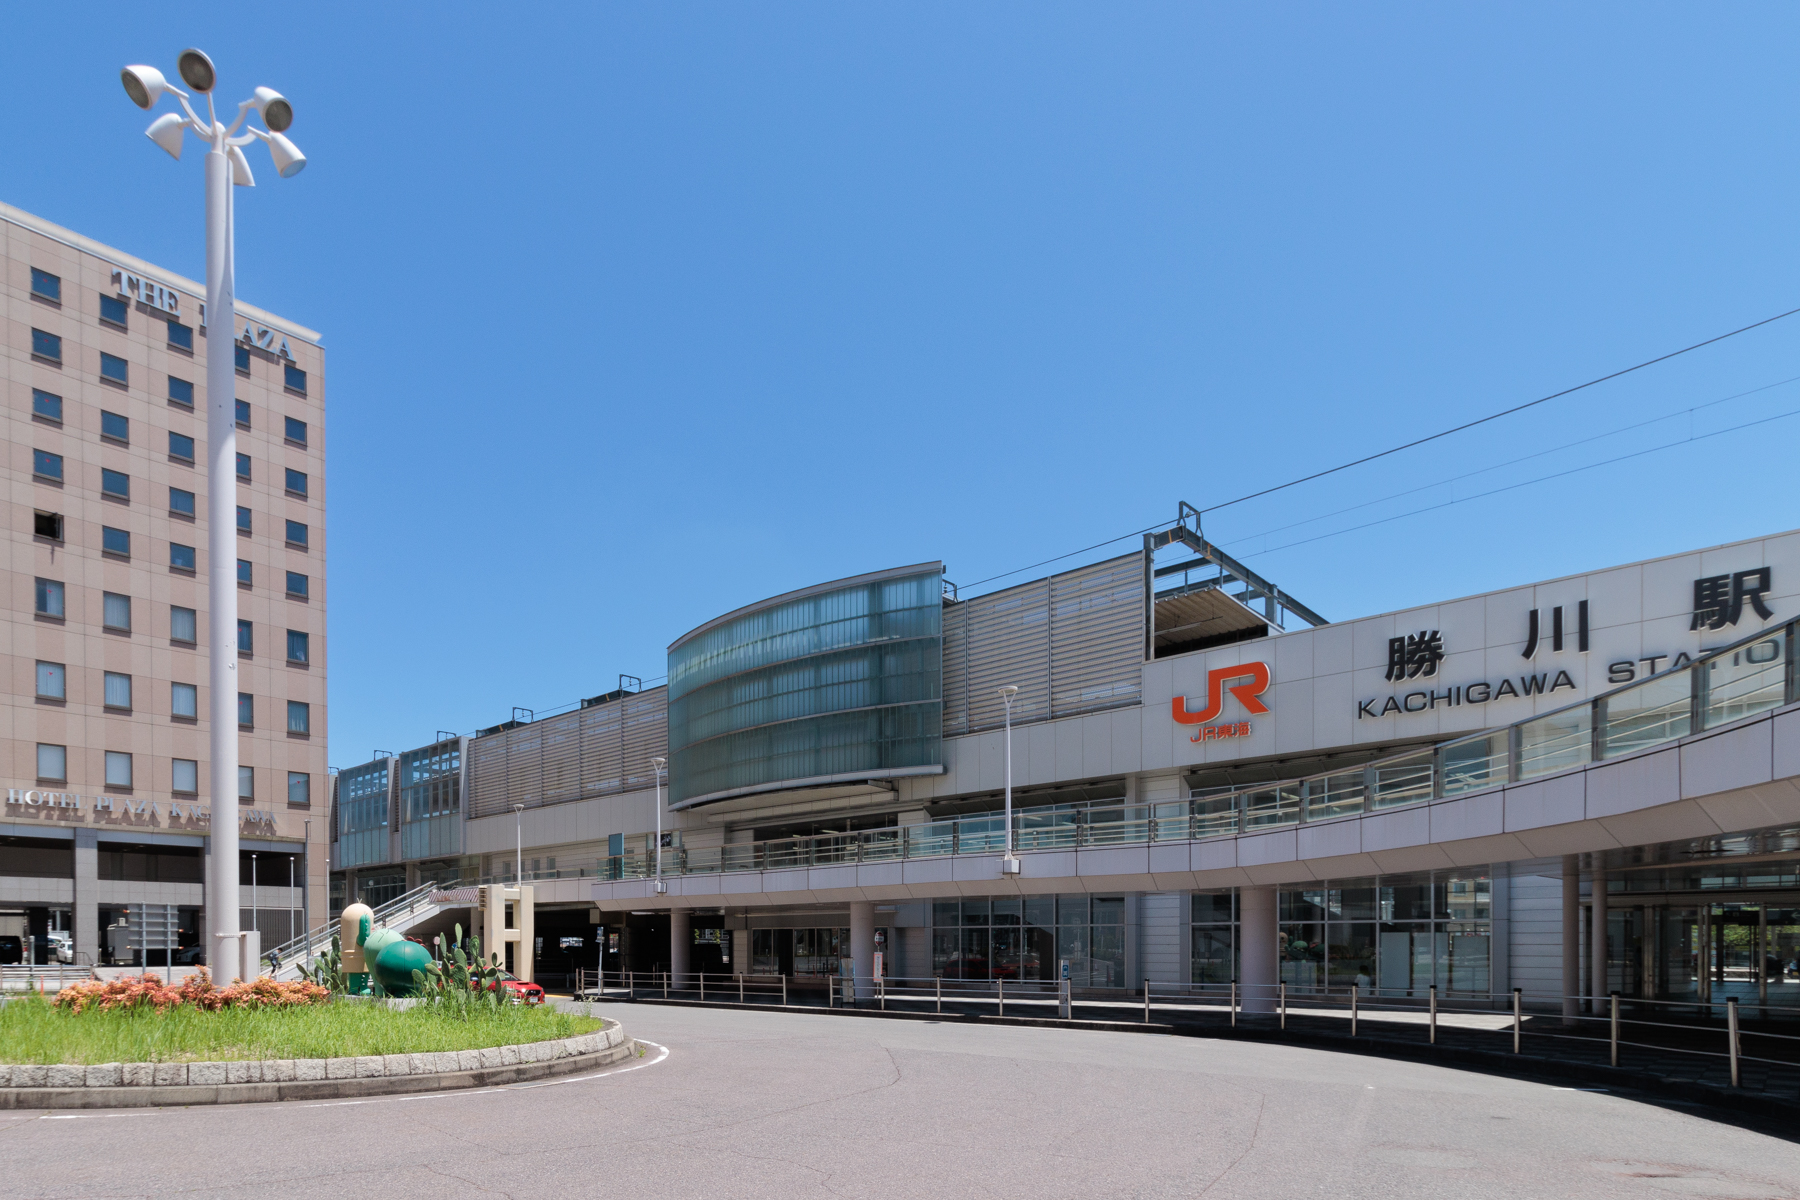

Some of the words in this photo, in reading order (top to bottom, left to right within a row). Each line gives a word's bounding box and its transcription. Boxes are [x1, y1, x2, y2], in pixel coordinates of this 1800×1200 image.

[111, 267, 181, 317] THE
[199, 302, 297, 363] AZA
[1172, 661, 1271, 725] JR
[1358, 669, 1577, 720] KACHIGAWA
[1608, 638, 1780, 684] STATIO
[1190, 722, 1252, 743] JR東海
[7, 788, 88, 809] HOTEL
[95, 796, 161, 815] PLAZA
[171, 802, 278, 824] KACAWA
